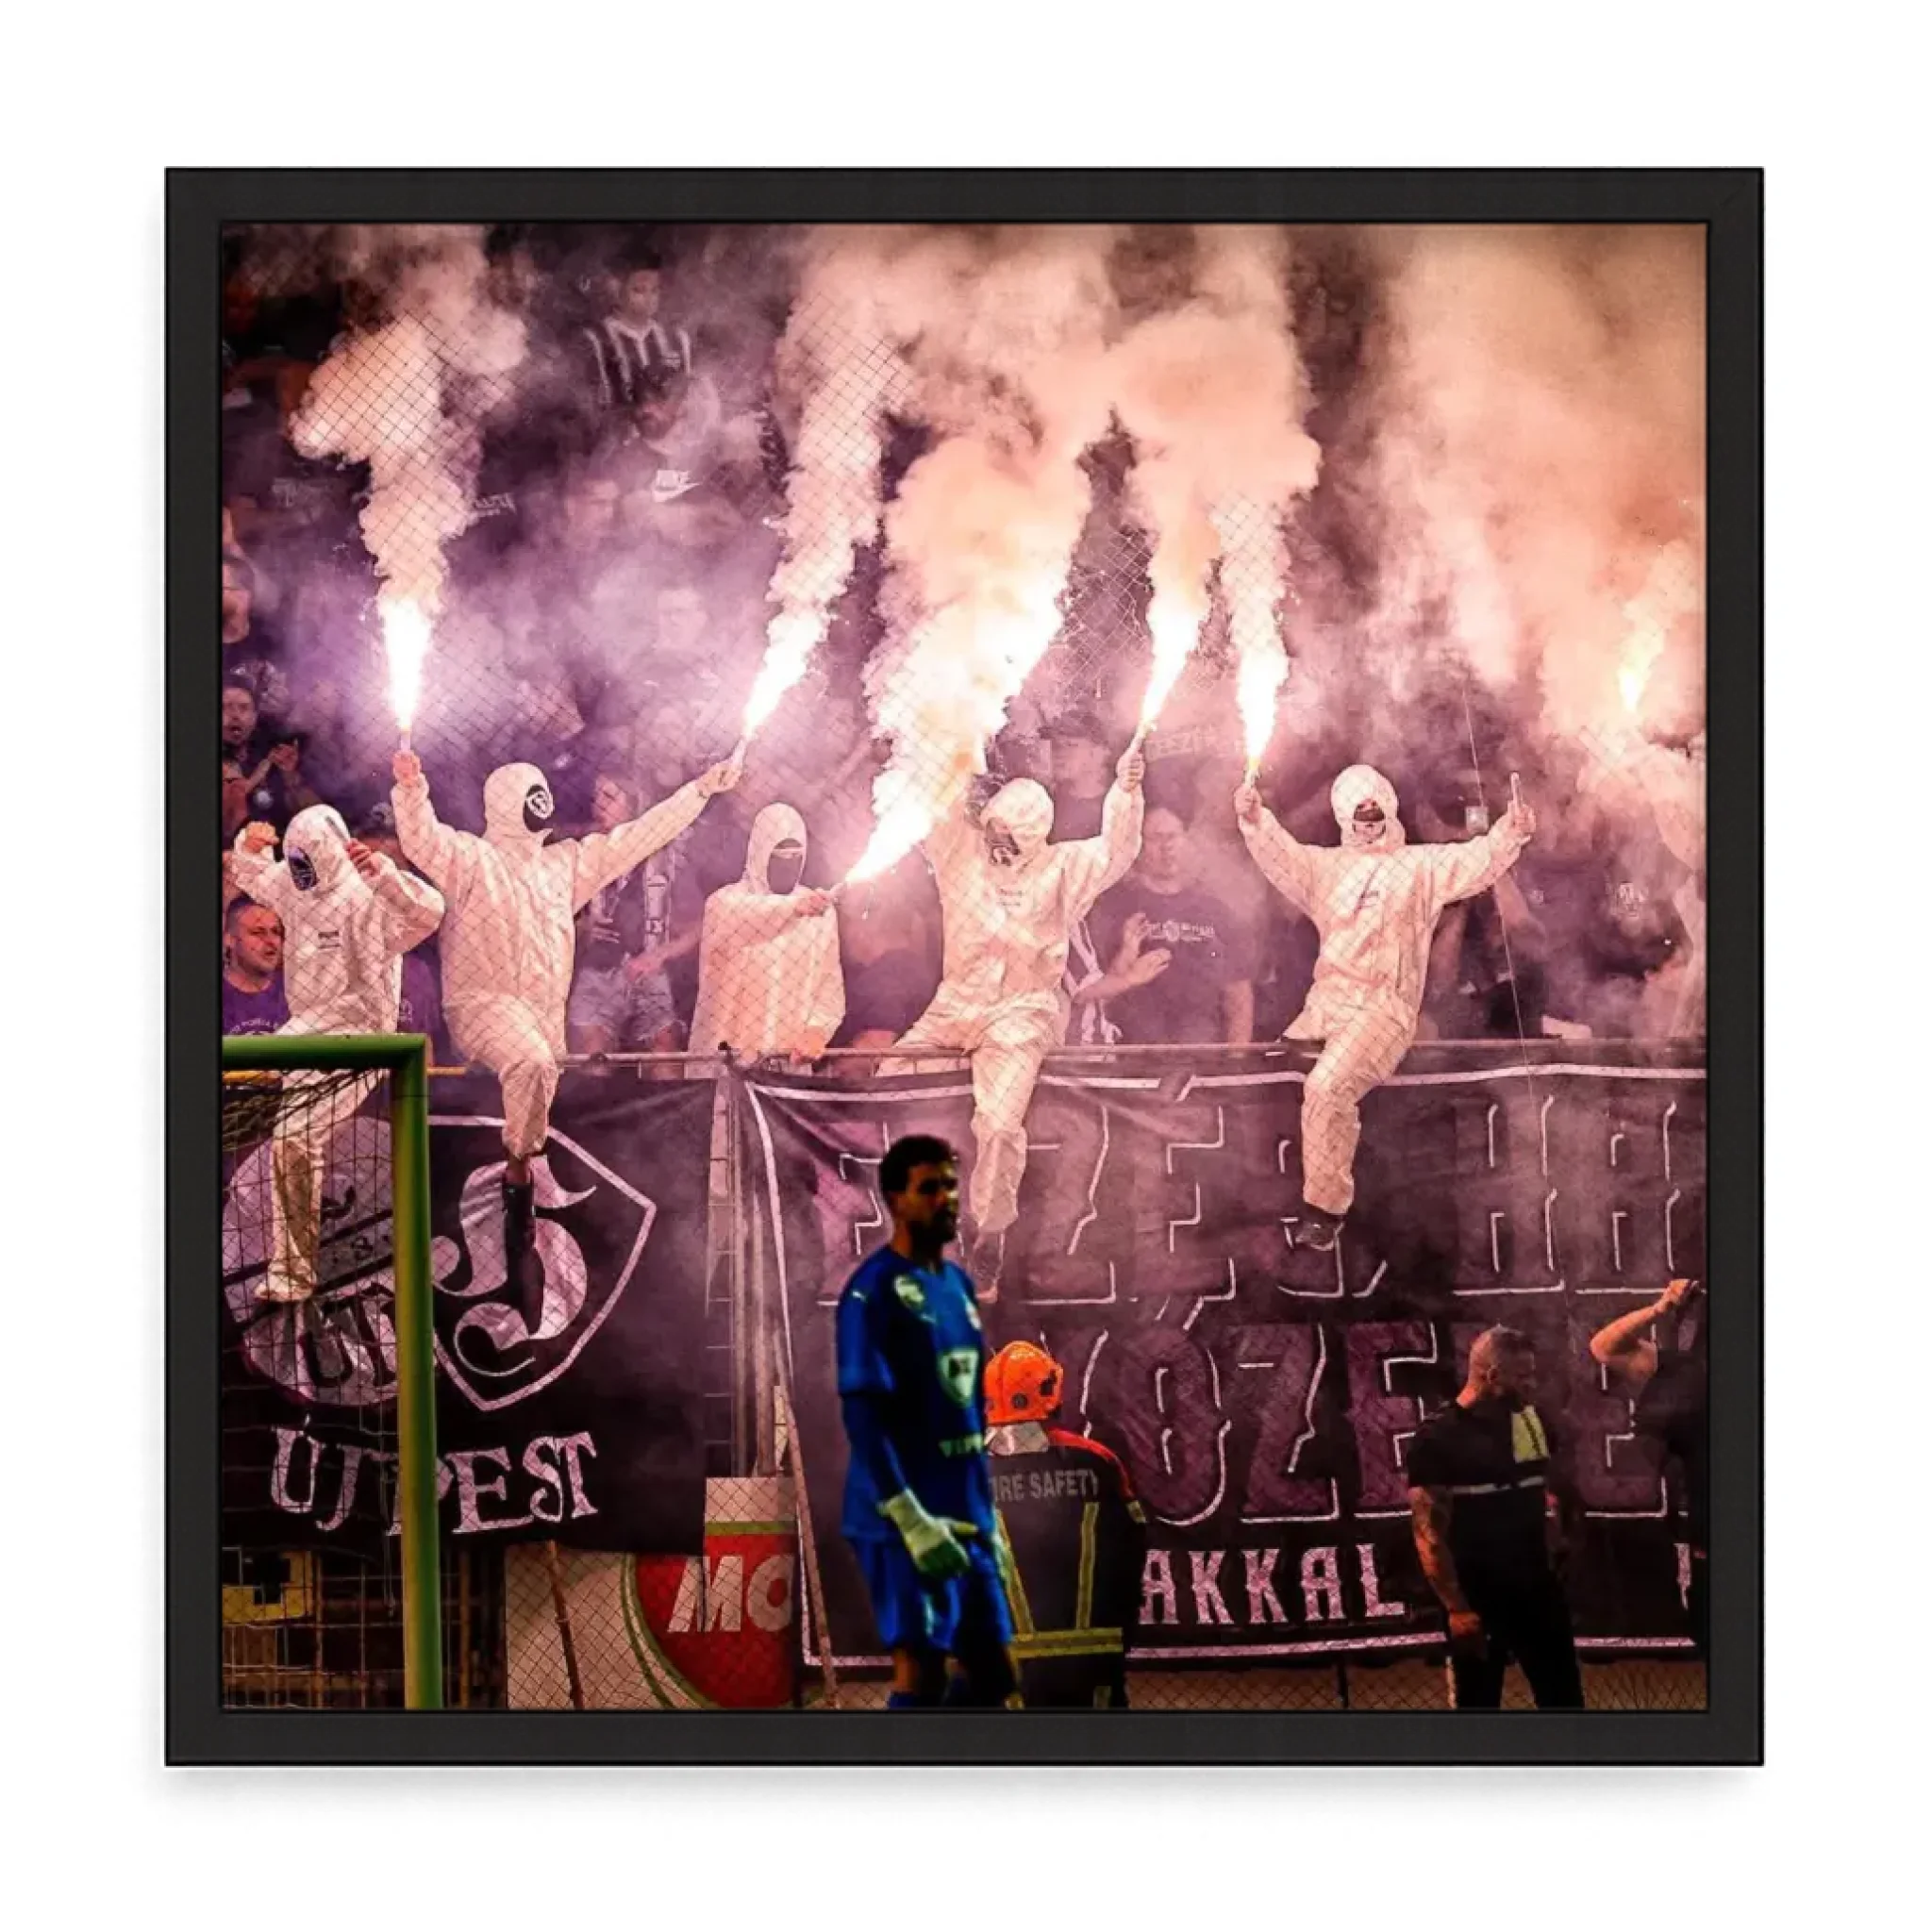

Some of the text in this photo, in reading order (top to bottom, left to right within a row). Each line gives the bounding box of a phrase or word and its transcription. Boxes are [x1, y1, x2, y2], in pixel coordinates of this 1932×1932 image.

[988, 1468, 1099, 1503] IRE SAFETY
[1138, 1542, 1406, 1624] AKKAL
